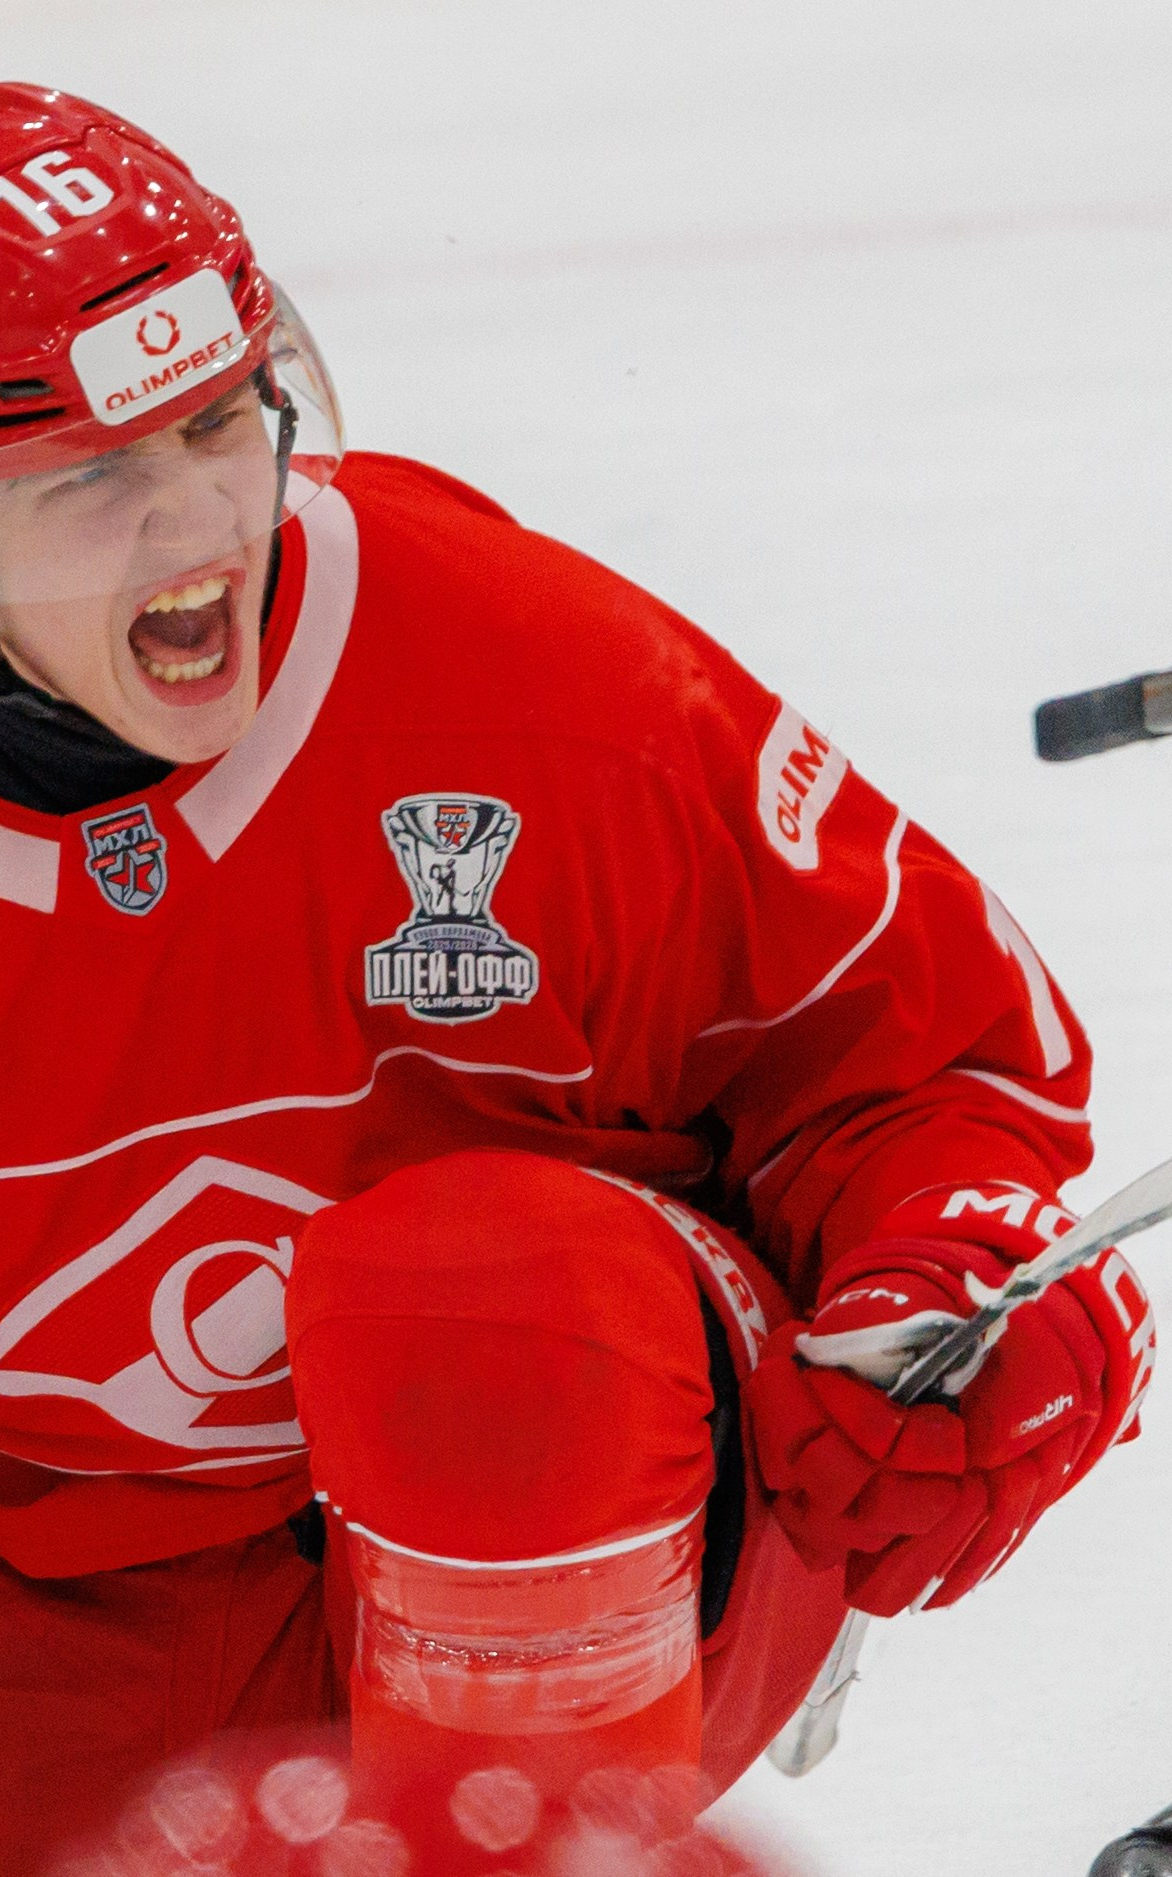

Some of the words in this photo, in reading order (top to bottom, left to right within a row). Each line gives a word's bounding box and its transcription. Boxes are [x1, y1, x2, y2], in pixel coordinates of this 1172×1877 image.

[105, 332, 233, 410] OLIMPBET
[93, 823, 152, 856] МХЛ
[373, 951, 529, 997] ПЛЕЙ-ОФФ
[413, 996, 494, 1008] OLIMPBET
